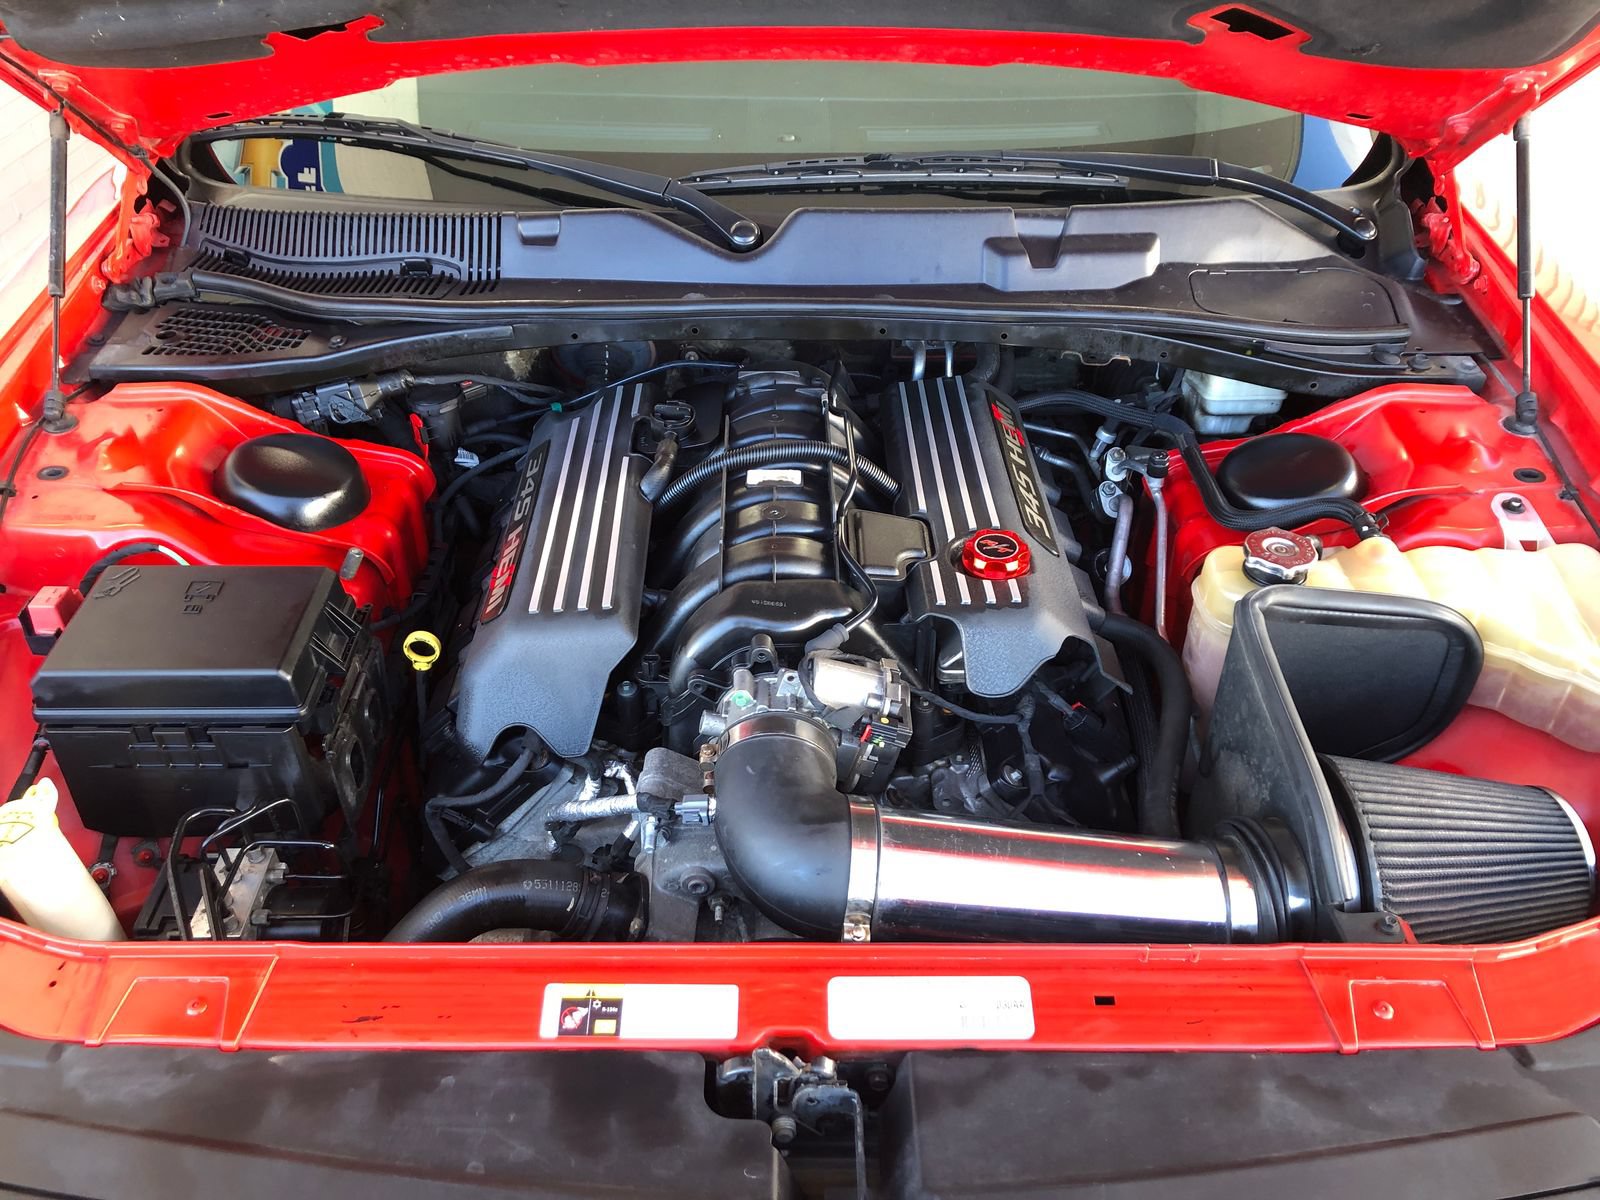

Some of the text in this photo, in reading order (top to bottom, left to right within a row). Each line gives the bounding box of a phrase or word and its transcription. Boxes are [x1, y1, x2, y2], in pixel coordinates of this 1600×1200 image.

[485, 452, 543, 615] 345 HEMI
[995, 400, 1051, 540] 345 HEMI
[534, 878, 581, 893] 5511128
